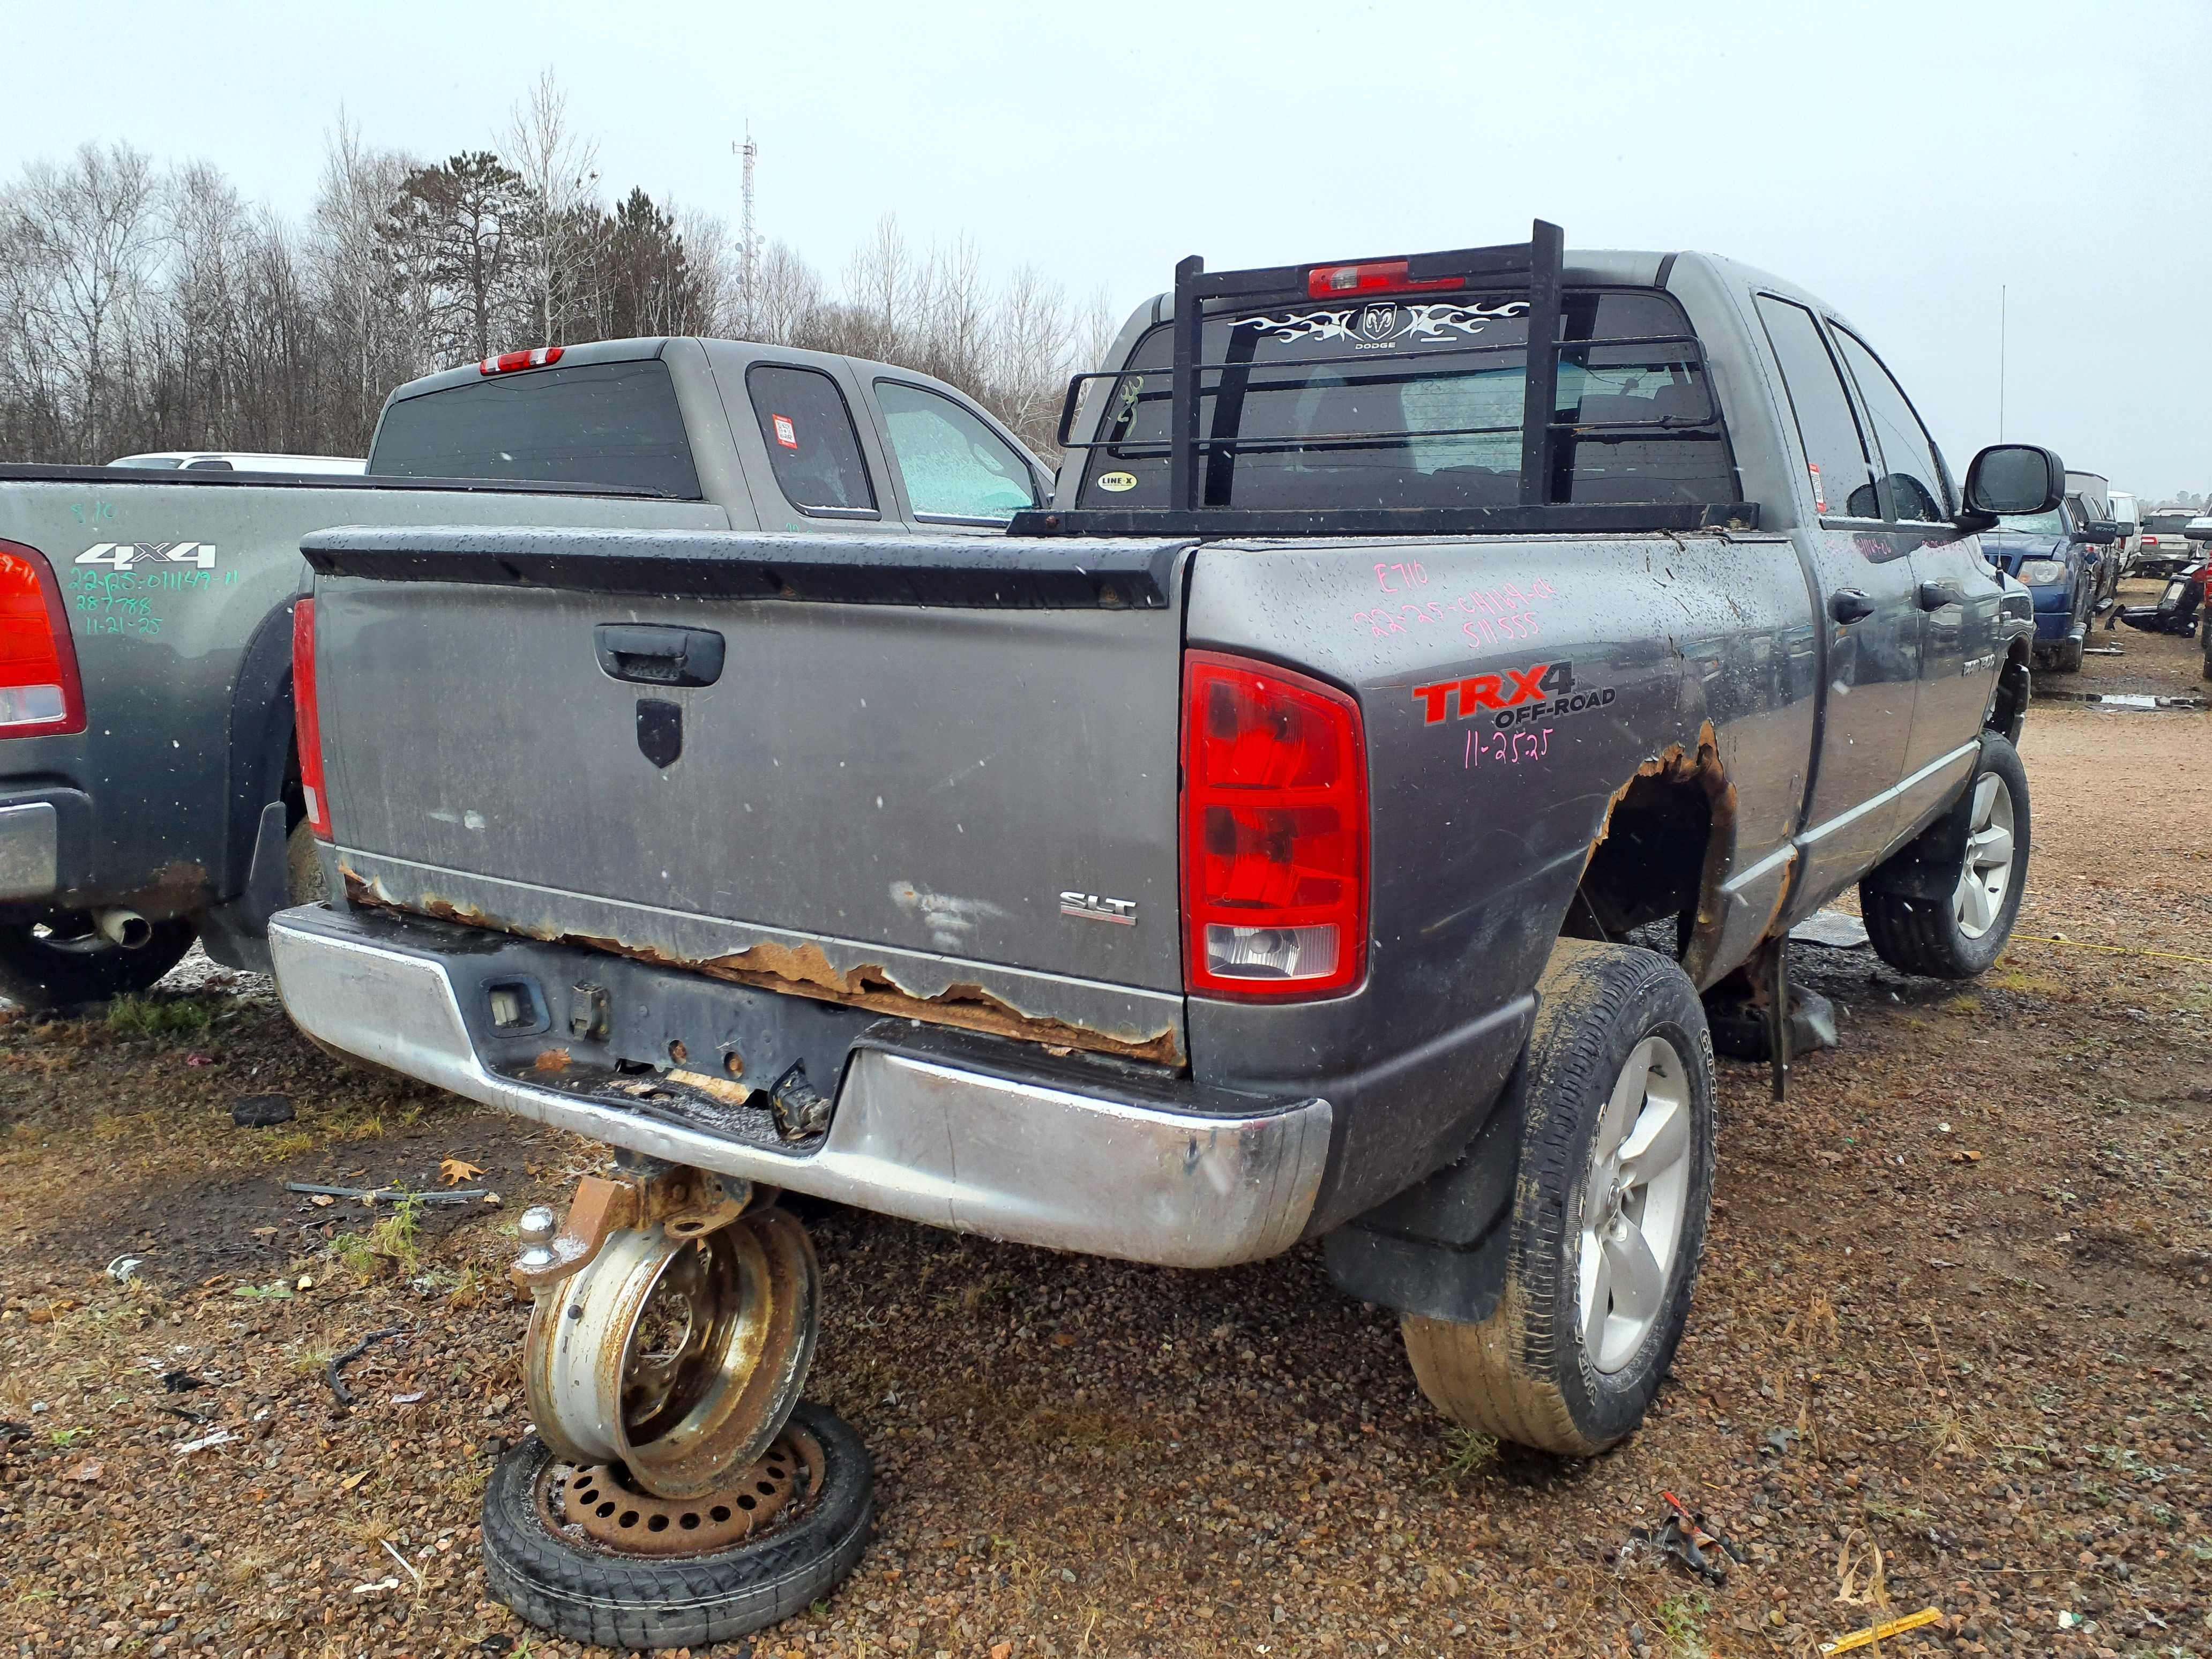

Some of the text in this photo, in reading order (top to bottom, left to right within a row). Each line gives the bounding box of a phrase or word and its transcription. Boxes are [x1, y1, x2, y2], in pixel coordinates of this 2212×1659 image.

[1413, 660, 1575, 724] TRX4
[1494, 688, 1616, 730] OFF-ROAD
[1060, 892, 1137, 914] SLT
